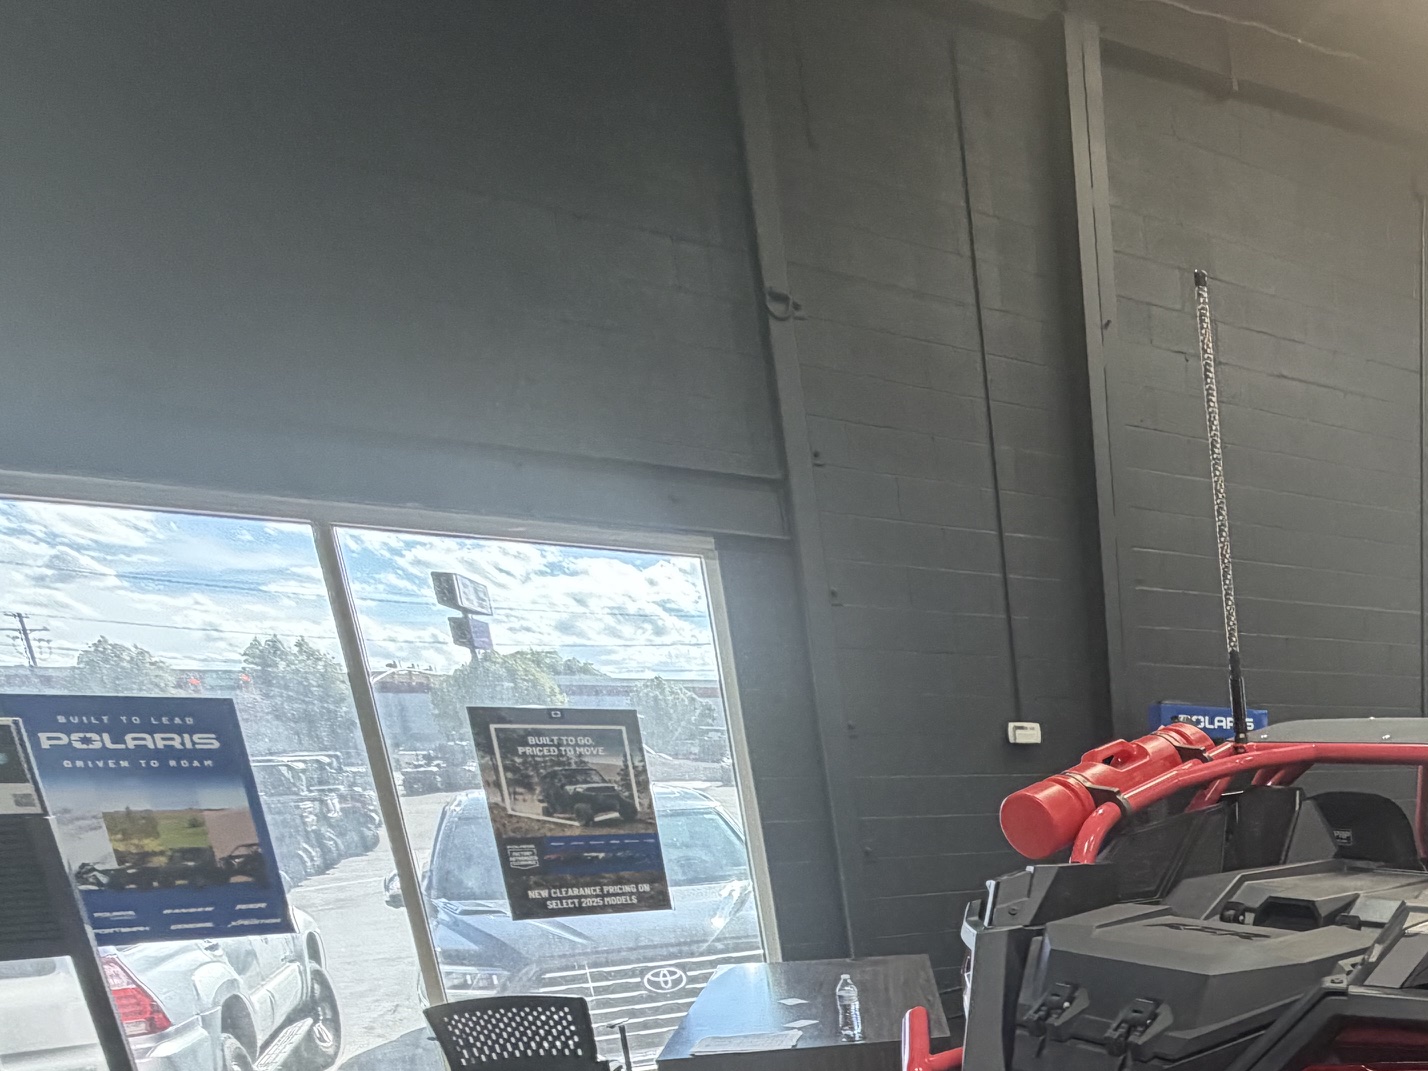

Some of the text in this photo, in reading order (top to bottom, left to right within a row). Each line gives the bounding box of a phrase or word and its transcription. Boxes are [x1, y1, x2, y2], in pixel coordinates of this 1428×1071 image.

[56, 715, 194, 725] BUILT TO LEAD
[37, 732, 221, 750] POLARIS
[527, 736, 559, 745] BUILT
[560, 736, 576, 745] TO
[517, 747, 606, 756] PRICED TO MOVE
[62, 760, 215, 768] DRIVEN TO ROAM
[527, 883, 651, 899] NEW CLEARANCE PRICING ON
[546, 895, 638, 909] SELECT 2025 MODELS
